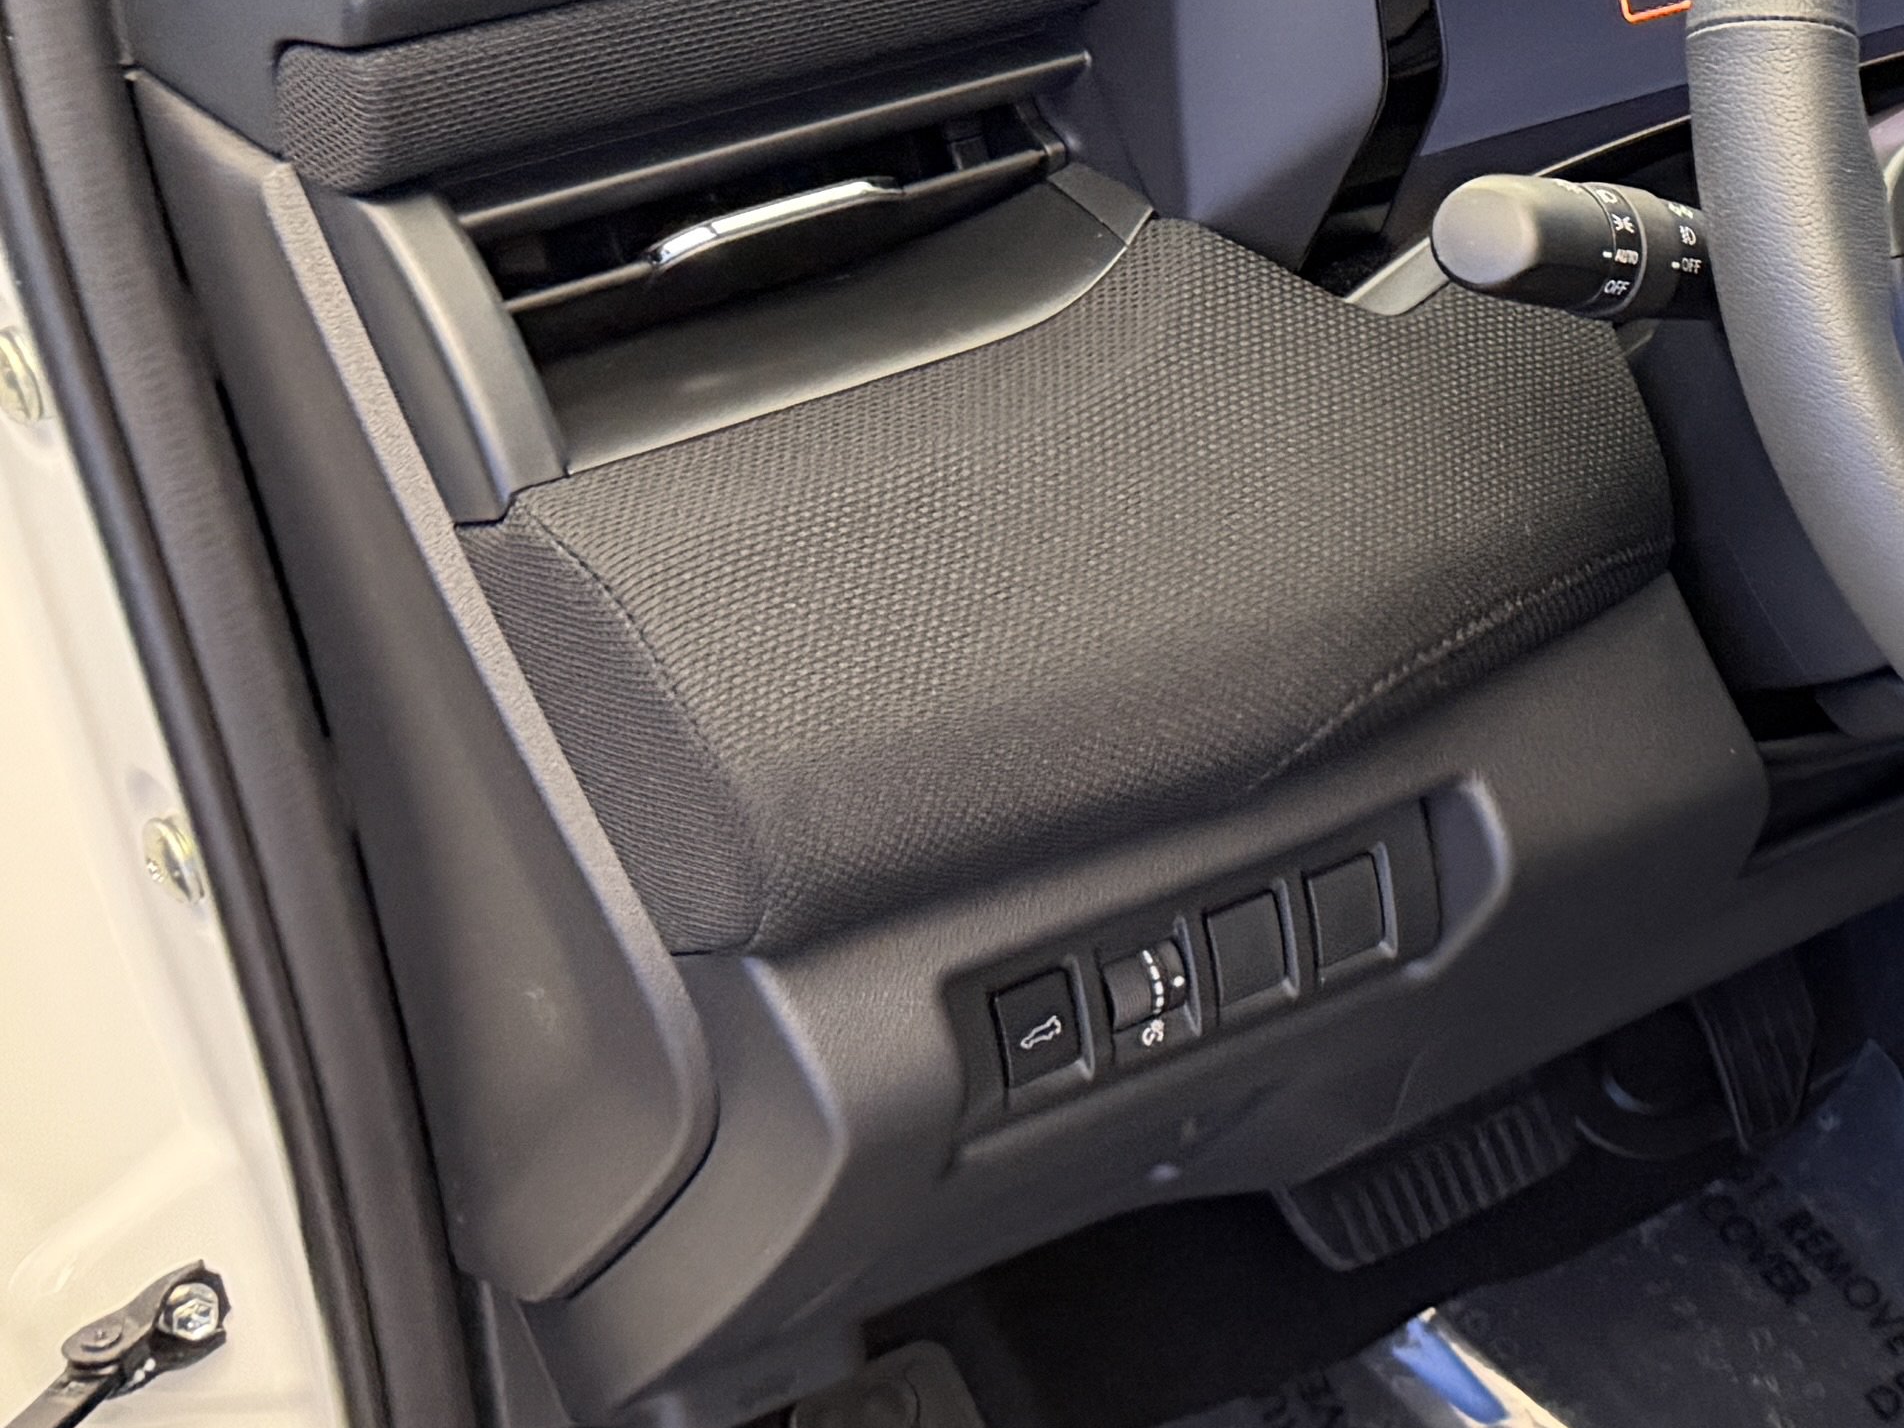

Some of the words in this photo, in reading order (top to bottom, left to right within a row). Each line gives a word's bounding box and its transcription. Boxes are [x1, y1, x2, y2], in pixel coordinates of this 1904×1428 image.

[1614, 248, 1639, 265] AUTO
[1681, 257, 1702, 274] OFF
[1604, 279, 1631, 295] OFF
